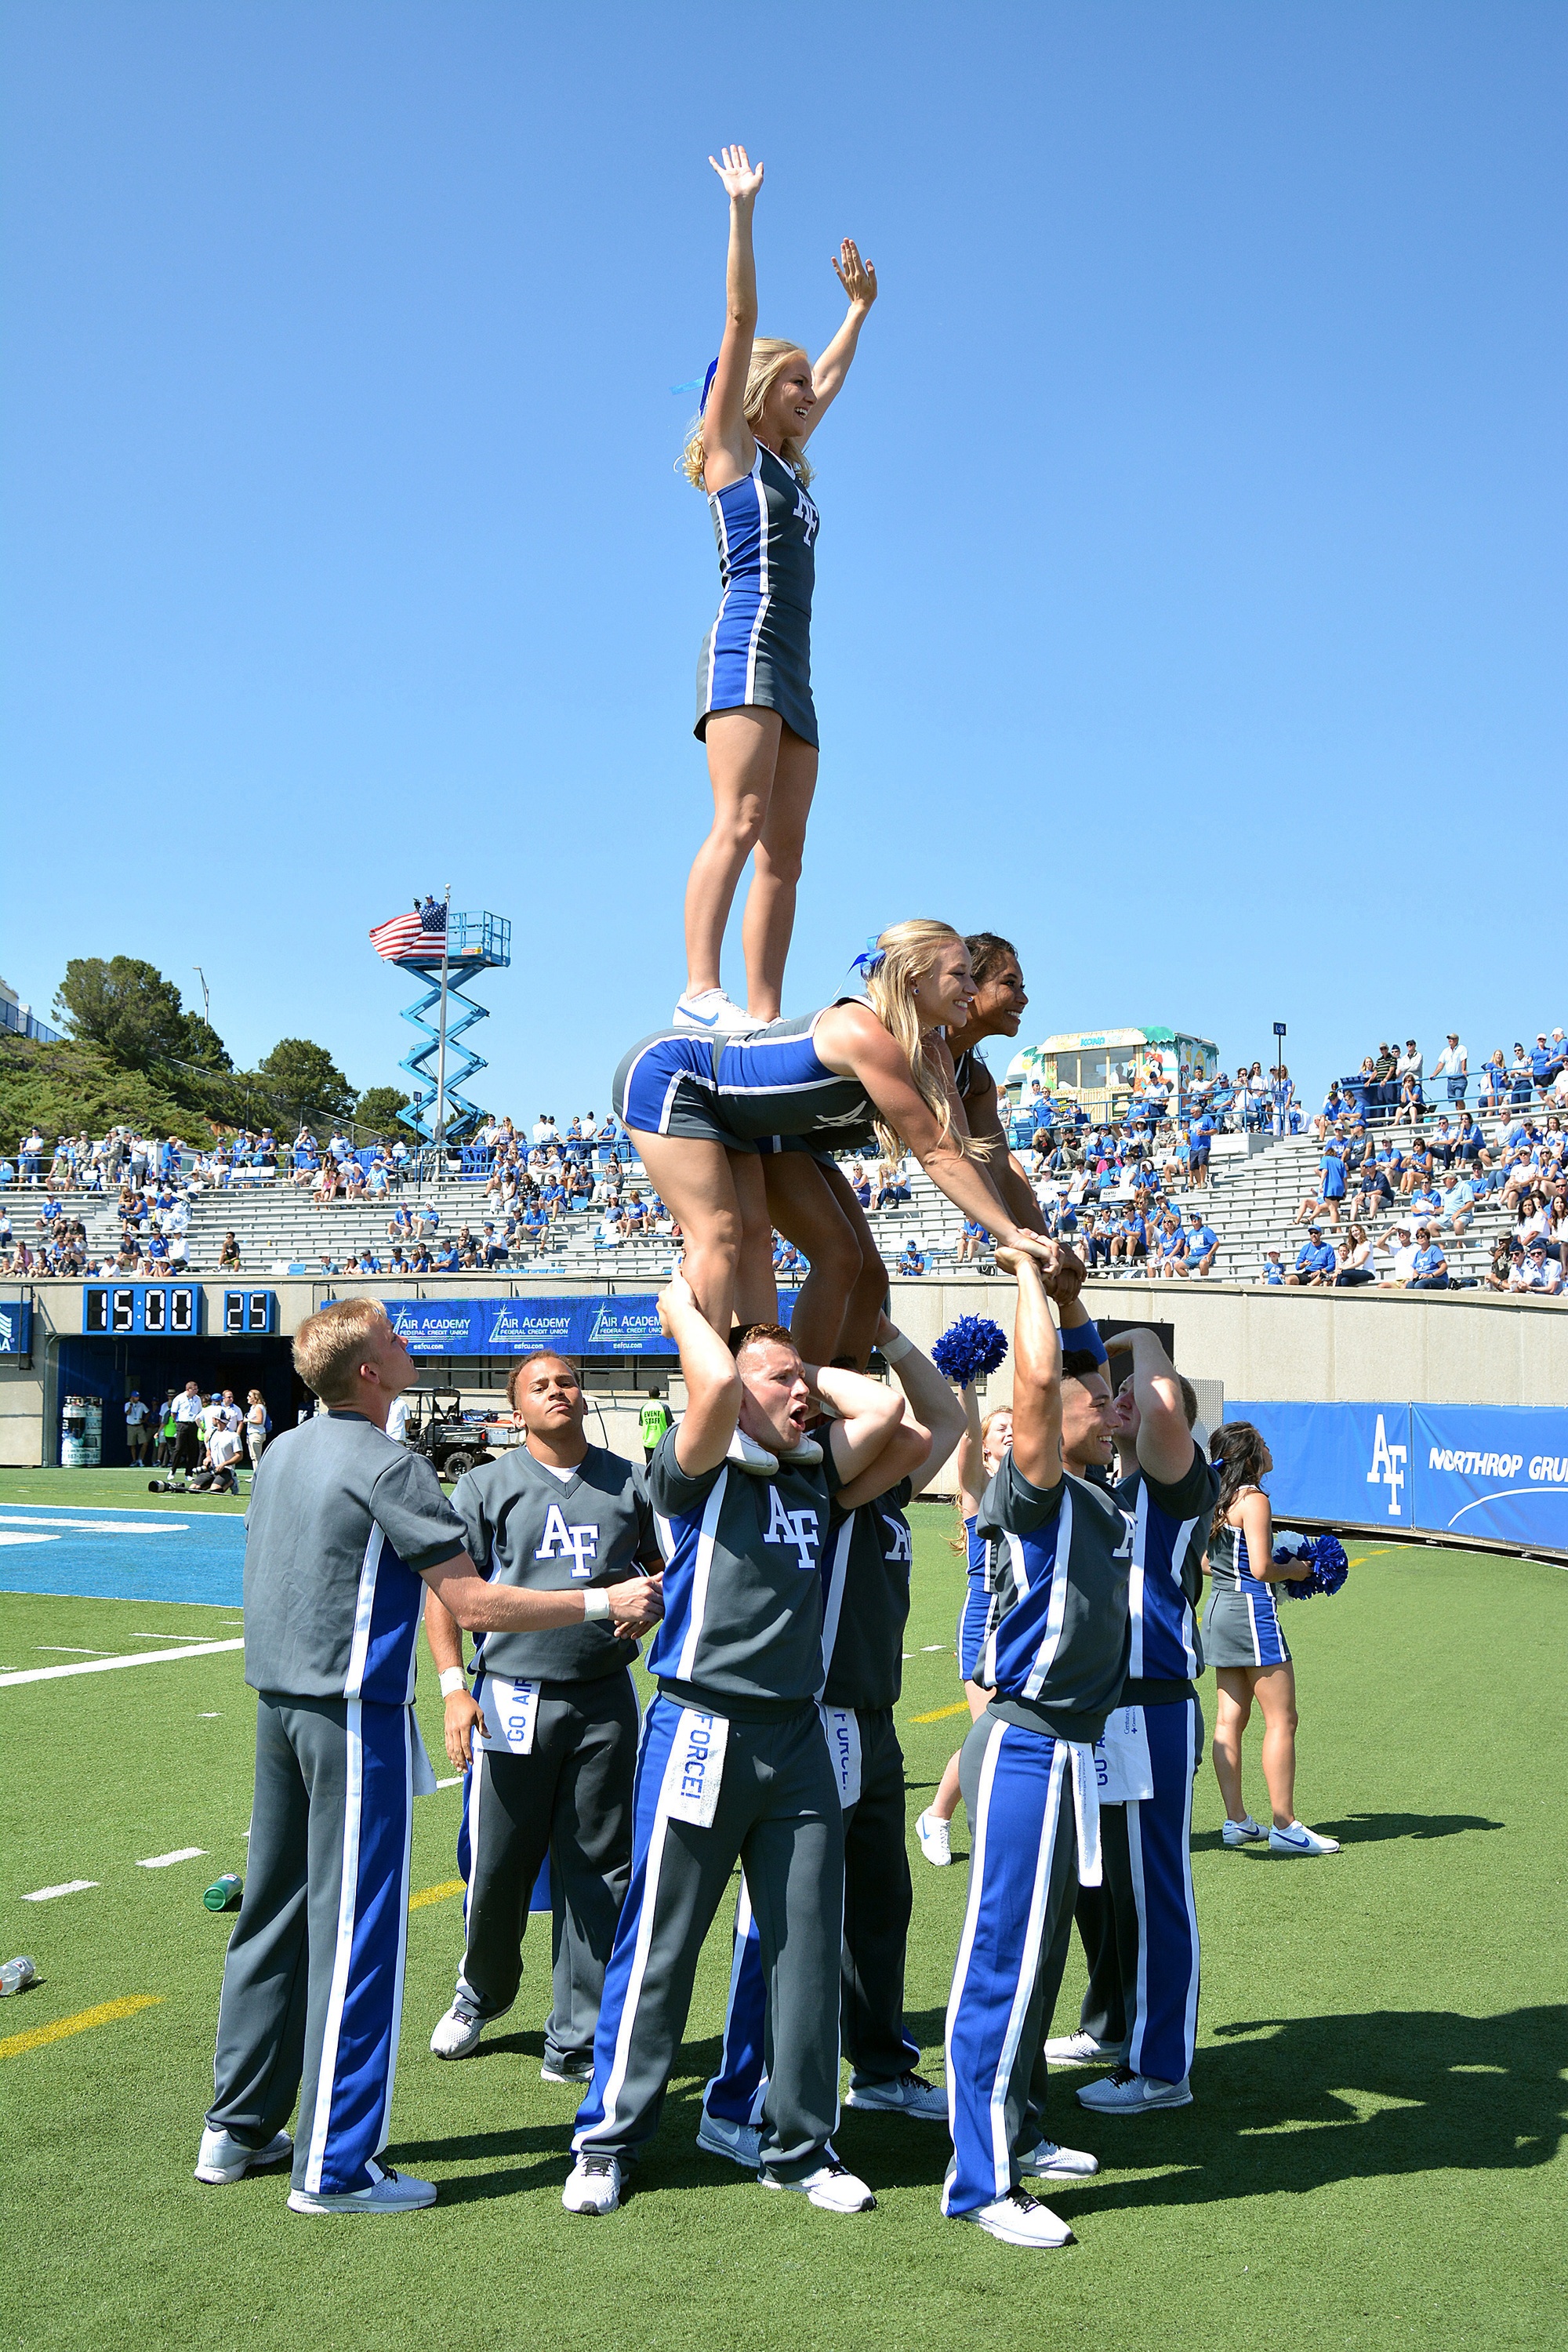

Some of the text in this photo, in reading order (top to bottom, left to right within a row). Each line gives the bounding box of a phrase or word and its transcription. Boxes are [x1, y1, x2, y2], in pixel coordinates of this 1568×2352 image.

[101, 1290, 191, 1330] 15:00
[227, 1294, 267, 1328] 25
[400, 1318, 471, 1329] AIR ACADEMY
[501, 1317, 571, 1328] AIR ACADEMY
[601, 1315, 662, 1327] AIR ACADEM
[1367, 1414, 1407, 1515] AF
[1428, 1447, 1568, 1483] NORTHROP GRU
[534, 1504, 600, 1579] AF
[763, 1484, 820, 1569] AF
[506, 1715, 527, 1742] GO
[681, 1713, 714, 1799] FORCE!
